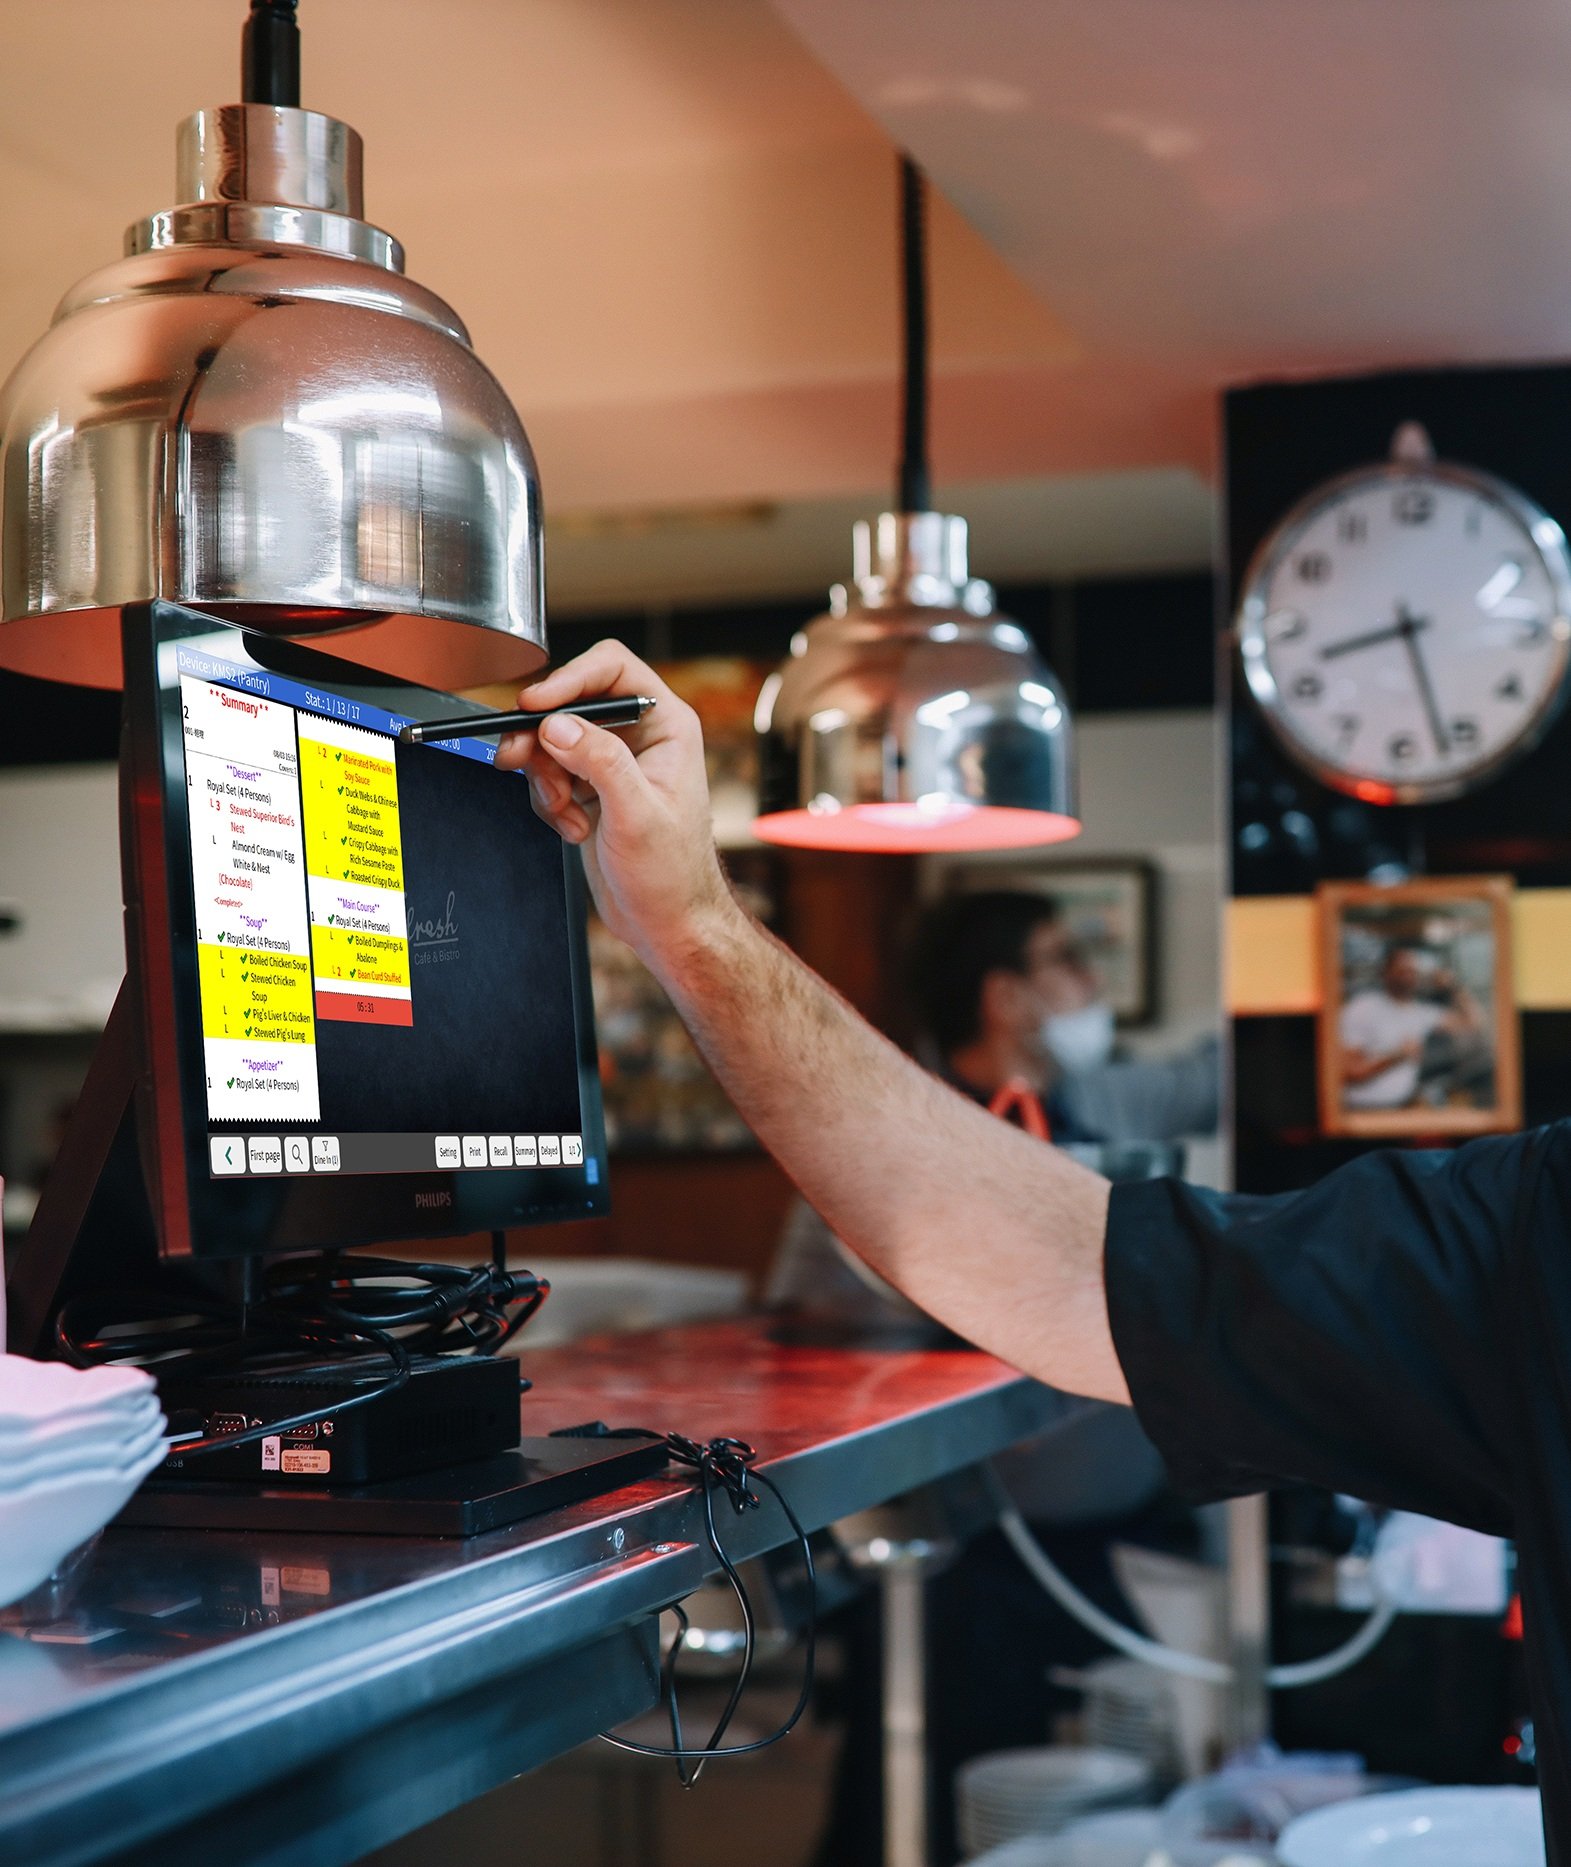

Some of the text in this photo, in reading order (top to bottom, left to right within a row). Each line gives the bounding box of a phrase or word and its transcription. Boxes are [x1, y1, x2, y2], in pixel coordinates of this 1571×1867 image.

[180, 651, 271, 696] Device: KMS2 (Pantry)
[183, 705, 189, 719] 2
[326, 698, 331, 711] 1
[337, 701, 346, 715] 13
[352, 705, 360, 720] 17
[322, 748, 327, 758] 2
[188, 775, 193, 786] 1
[344, 770, 371, 786] Soy Sauce
[207, 779, 272, 806] Royal Set (4 Persons)
[345, 786, 359, 799] Duck
[378, 795, 398, 809] Chinese
[216, 800, 221, 811] 3
[229, 803, 252, 818] Stewed
[253, 808, 278, 823] Superior
[346, 803, 381, 820] Cabbage with
[230, 821, 245, 835] Nest
[347, 820, 384, 838] Mustard Sauce
[232, 840, 256, 854] Almond
[256, 844, 276, 858] Cream
[284, 850, 295, 864] Egg
[348, 837, 365, 852] Crispy
[365, 841, 387, 856] Cabbage
[387, 846, 399, 857] with
[233, 858, 251, 871] White
[257, 862, 271, 875] Nest
[349, 853, 396, 872] Rich Sesame Paste
[350, 870, 372, 884] Roasted
[372, 874, 388, 889] Crispy
[388, 878, 400, 889] Duck
[335, 914, 352, 929] Royal
[352, 917, 361, 929] Set
[368, 920, 391, 934] Persons)
[198, 928, 202, 940] 1
[226, 932, 291, 953] Royal Set (4 Persons)
[355, 935, 372, 947] Boiled
[372, 938, 399, 953] Dumplings
[249, 954, 269, 967] Boiled
[269, 956, 292, 969] Chicken
[292, 960, 308, 973] Soup
[356, 953, 377, 964] Abalone
[250, 972, 274, 985] Stewed
[274, 974, 297, 987] Chicken
[357, 969, 371, 979] Bean
[251, 990, 268, 1004] Soup
[252, 1008, 267, 1022] Pig's
[267, 1010, 282, 1021] Liver
[288, 1011, 311, 1023] Chicken
[253, 1027, 276, 1039] Stewed
[276, 1028, 291, 1042] Pig's
[291, 1029, 306, 1043] Lung
[207, 1076, 212, 1088] 1
[236, 1077, 300, 1092] Royal Set (4 Persons)
[250, 1149, 281, 1163] First page
[440, 1147, 457, 1159] Setting
[469, 1146, 481, 1157] Print
[494, 1146, 508, 1157] Recall
[515, 1146, 536, 1158] Summary
[540, 1146, 558, 1157] Delayed
[415, 1191, 451, 1209] PHILIPS
